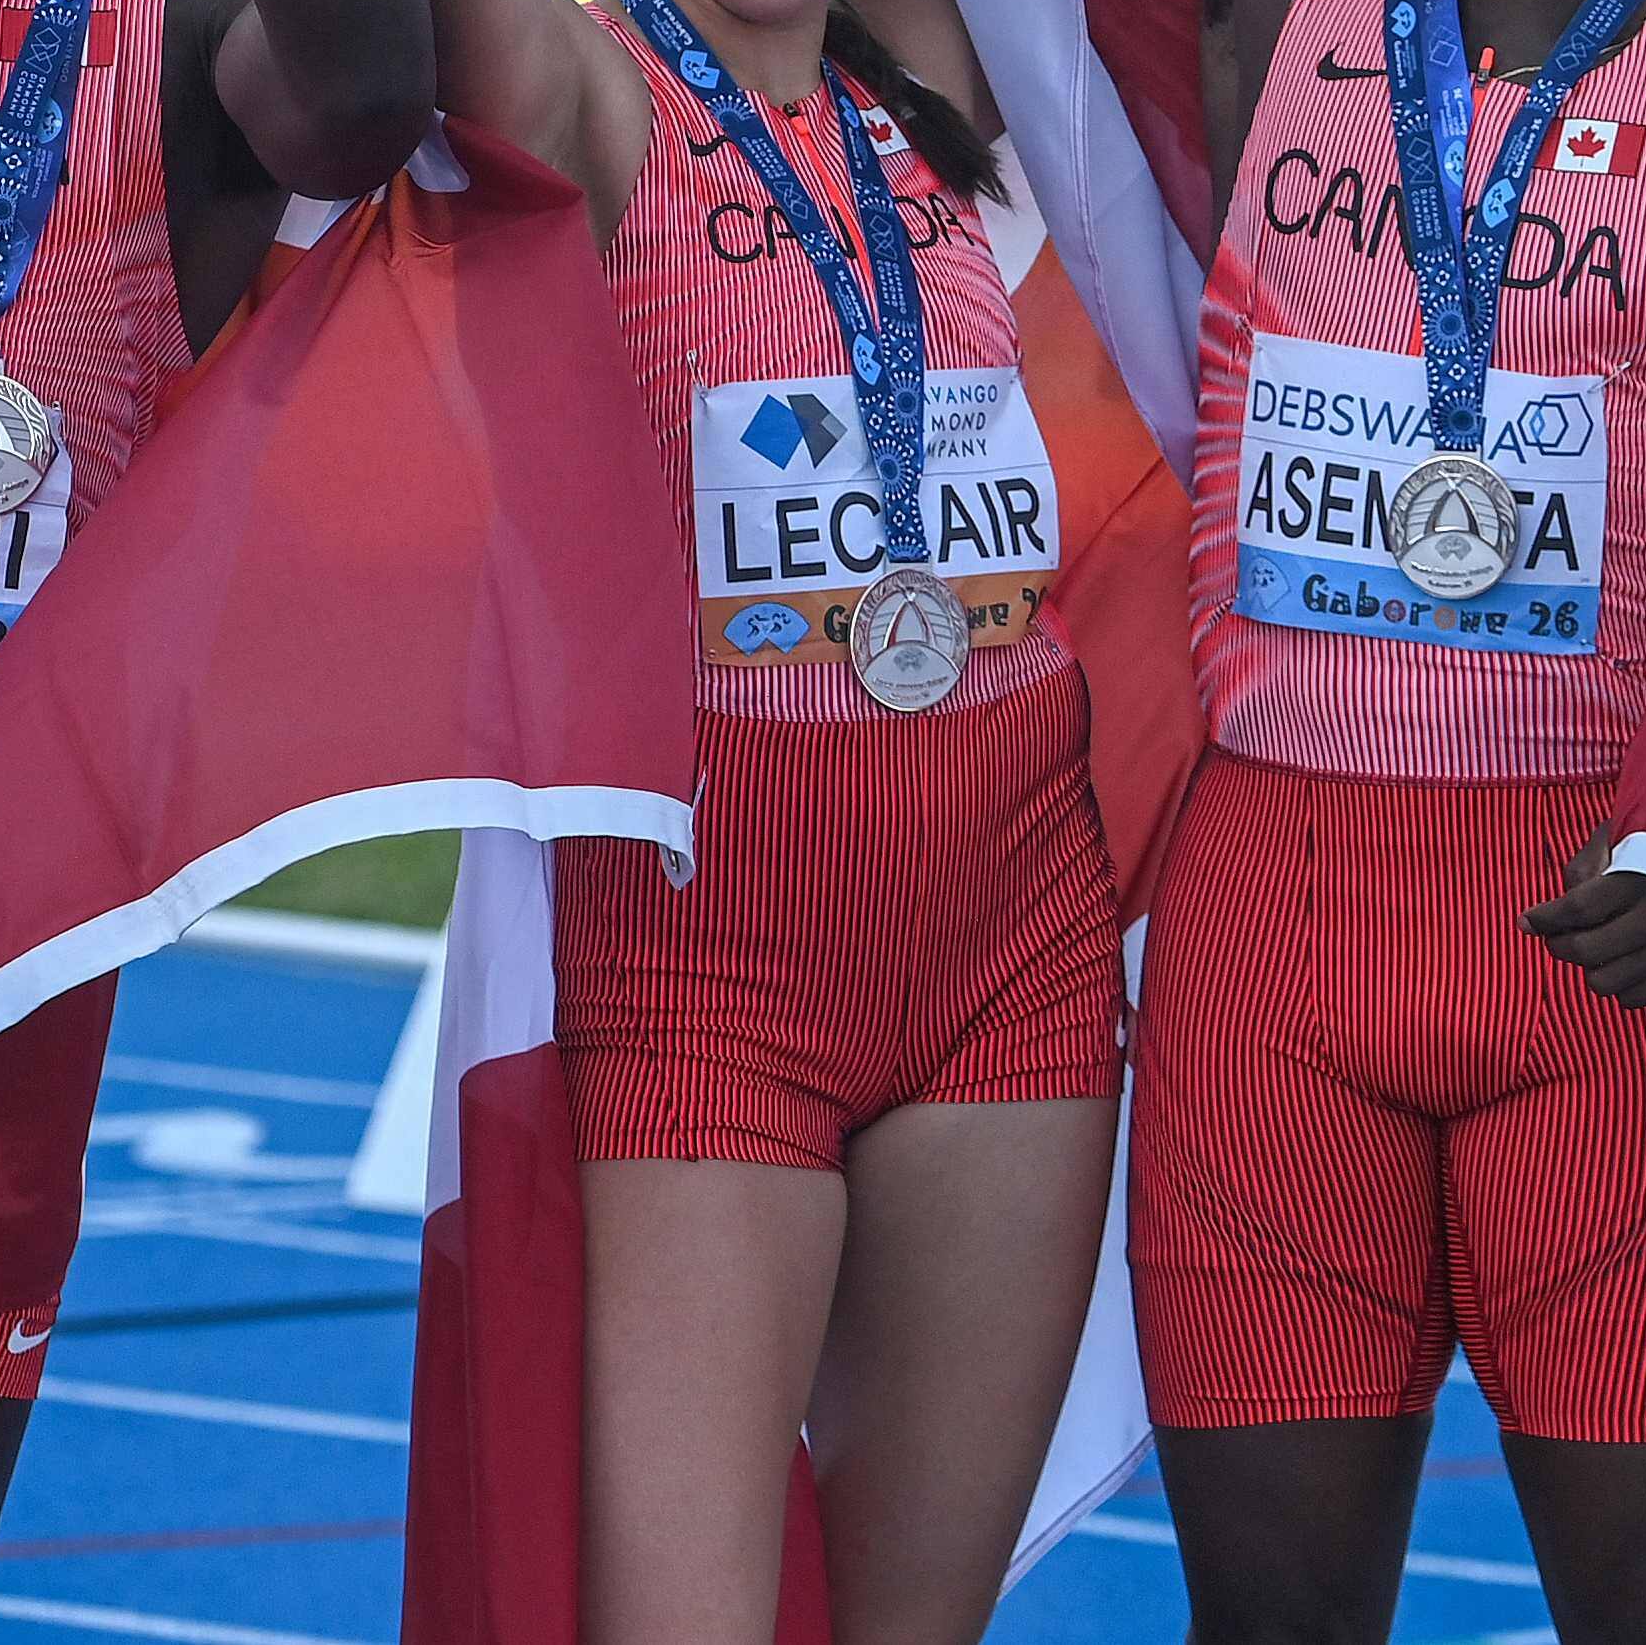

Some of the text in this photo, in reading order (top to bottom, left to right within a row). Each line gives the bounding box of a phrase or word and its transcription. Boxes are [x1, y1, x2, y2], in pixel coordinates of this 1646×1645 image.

[707, 194, 974, 263] CADA
[1266, 150, 1624, 311] CANDA
[924, 384, 998, 405] VANGO
[1252, 379, 1525, 464] DEBSWAA
[926, 438, 988, 458] MPANY
[931, 412, 987, 432] MOND
[722, 477, 1045, 583] LECAIR
[1527, 600, 1579, 640] 26
